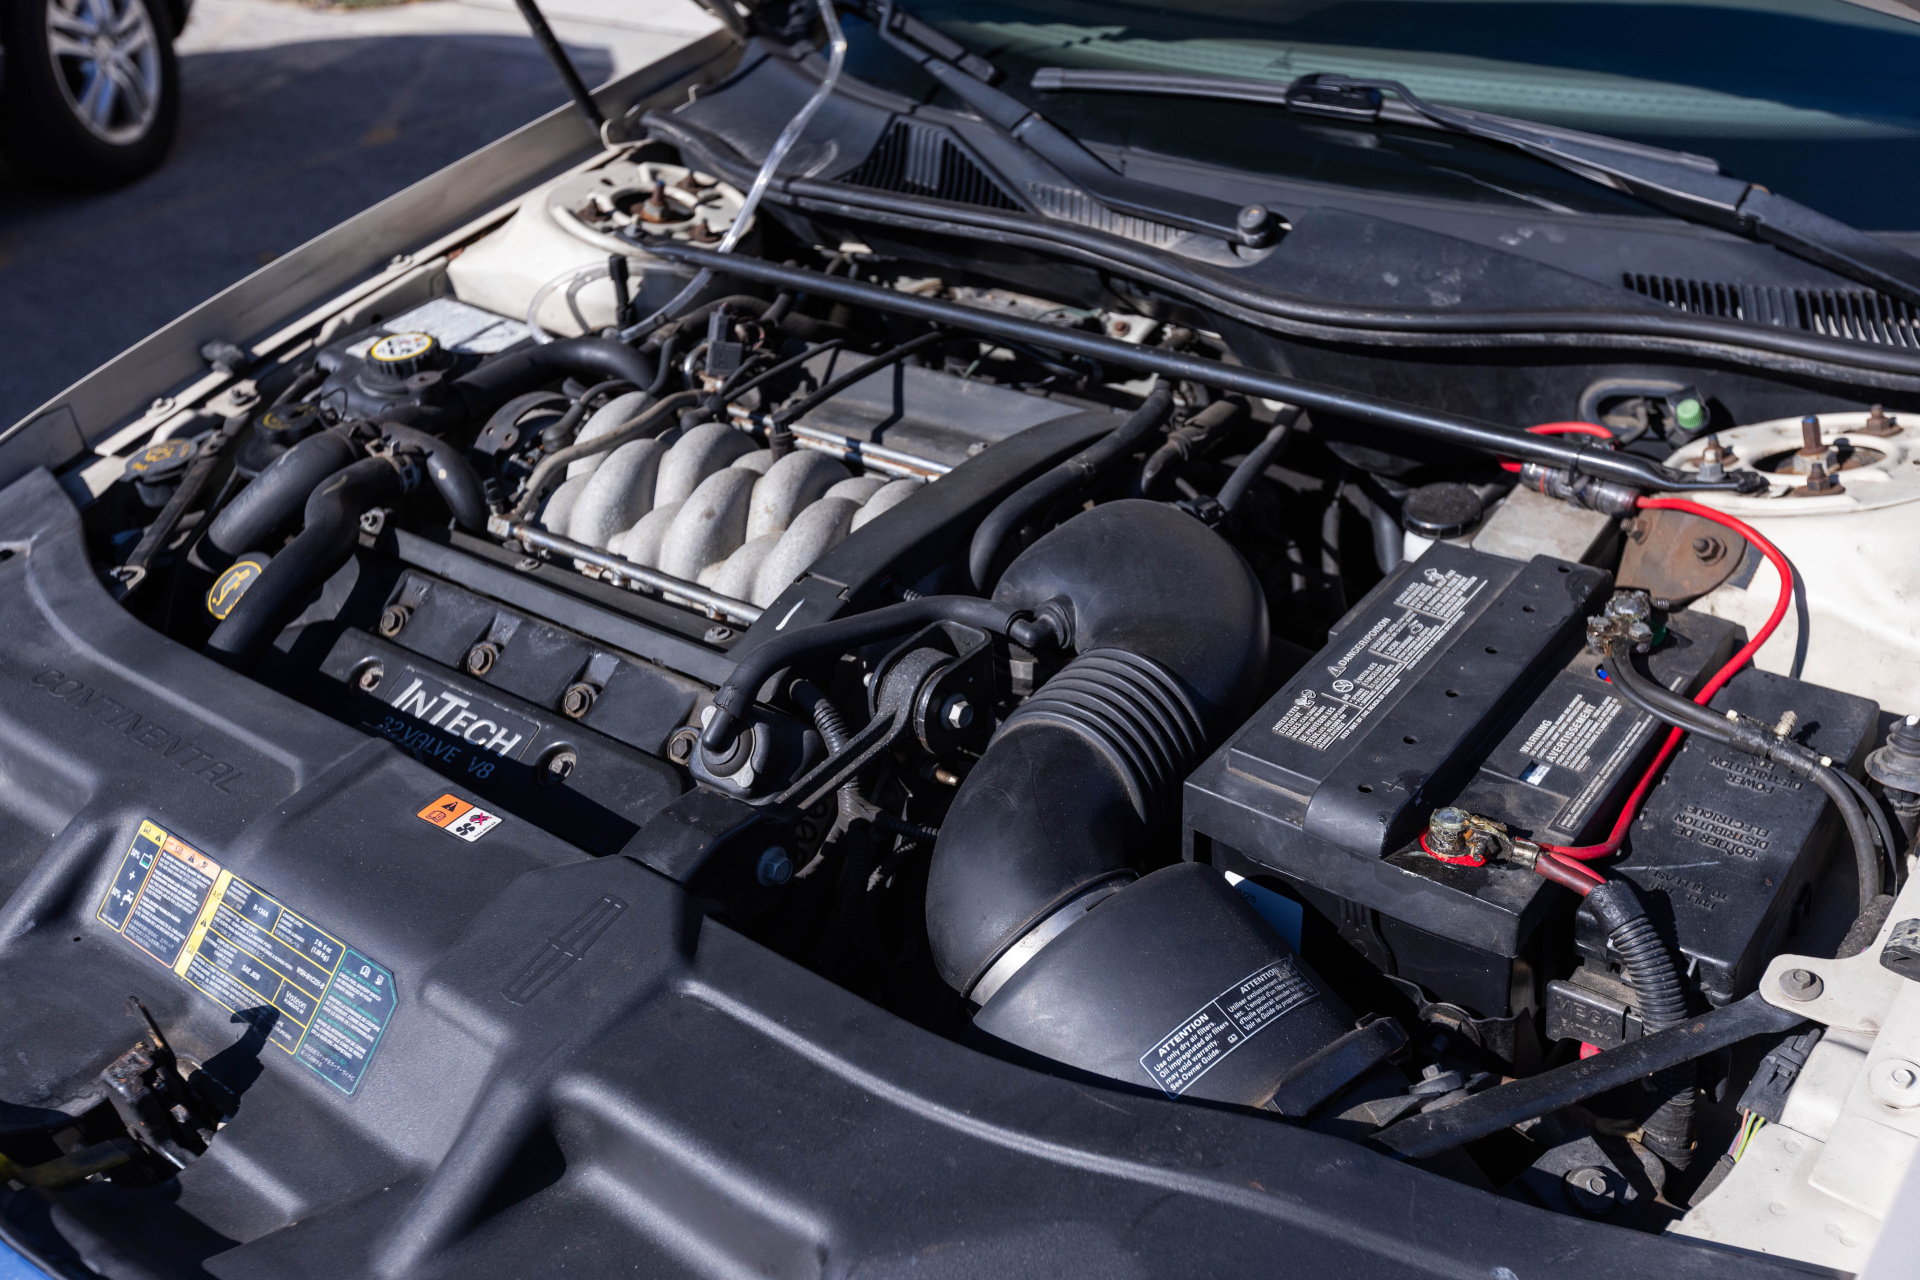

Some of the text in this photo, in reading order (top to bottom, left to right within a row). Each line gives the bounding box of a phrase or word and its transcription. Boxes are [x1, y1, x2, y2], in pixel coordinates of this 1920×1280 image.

[1337, 616, 1391, 666] DANGER/POISON
[30, 668, 245, 795] CONTINENTAL
[1518, 719, 1554, 752] WARNING
[1543, 702, 1597, 761] AVERTISSEMENT
[467, 755, 496, 779] V8
[1709, 755, 1803, 791] DISTRIBUTION
[1725, 771, 1774, 795] POWER
[1672, 812, 1769, 850] DISTRIBUTION
[1673, 825, 1694, 838] DE
[285, 990, 307, 1010] Visteon
[1556, 995, 1618, 1033] MEGA
[1152, 1058, 1168, 1072] Use
[1165, 1047, 1181, 1062] only
[1177, 1039, 1191, 1052] dry
[1188, 1032, 1199, 1042] air
[1155, 1012, 1209, 1057] ATTENTION
[1158, 1018, 1229, 1078] Oil impregnated air filters
[1164, 1070, 1180, 1085] may
[1176, 1058, 1193, 1073] void
[1168, 1077, 1184, 1091] See
[1180, 1061, 1203, 1081] Owner
